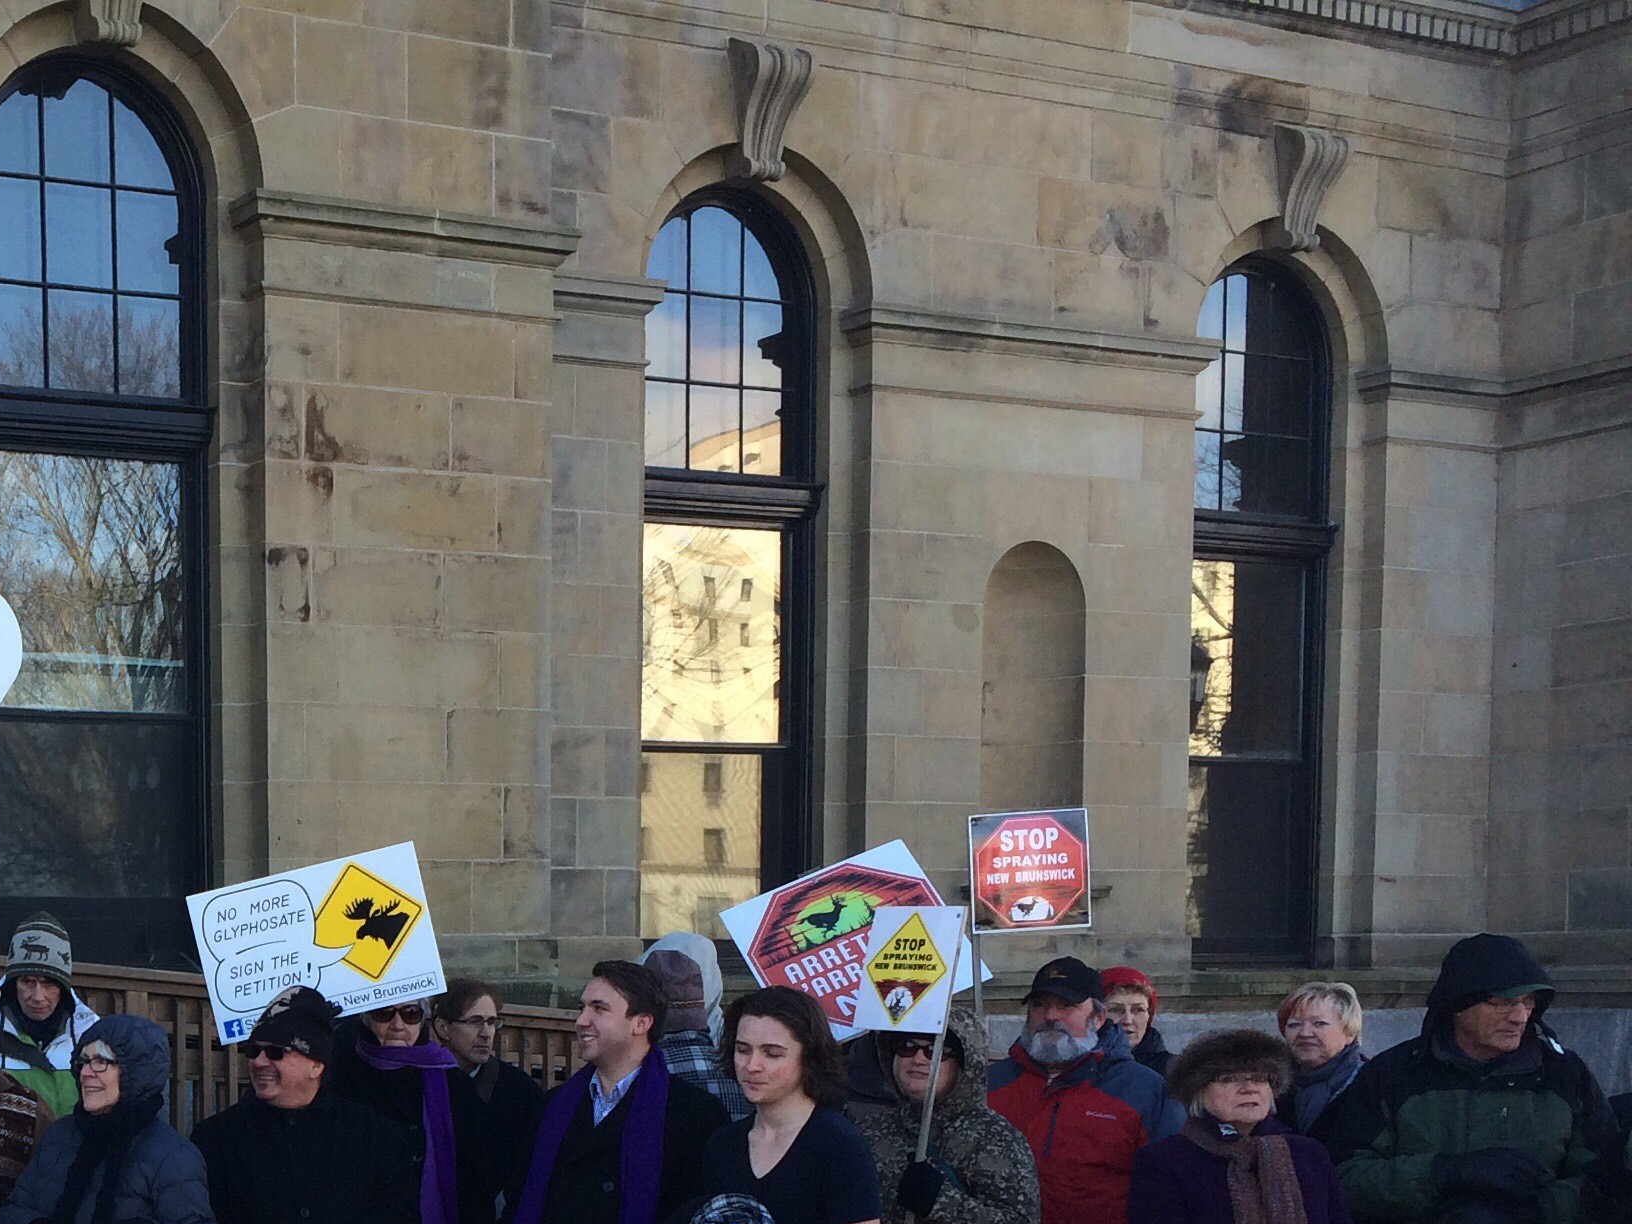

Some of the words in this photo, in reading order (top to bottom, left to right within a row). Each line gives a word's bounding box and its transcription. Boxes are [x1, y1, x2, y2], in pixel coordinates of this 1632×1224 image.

[1000, 827, 1058, 852] STOP
[993, 852, 1068, 869] SPRAYING
[987, 873, 1009, 885] NEW
[1015, 868, 1076, 883] BRUNSWICK
[217, 907, 237, 924] NO
[250, 894, 290, 915] MORE
[213, 909, 306, 943] GLYPHOSATE
[894, 938, 926, 951] STOP
[229, 959, 264, 979] SIGN
[271, 951, 299, 970] THE
[784, 931, 871, 985] ARRÊT
[874, 962, 890, 970] NEW
[893, 963, 937, 971] BRUNSWICK
[883, 953, 933, 962] SPRAYING
[343, 992, 371, 1008] New
[373, 976, 435, 1000] Brunswick
